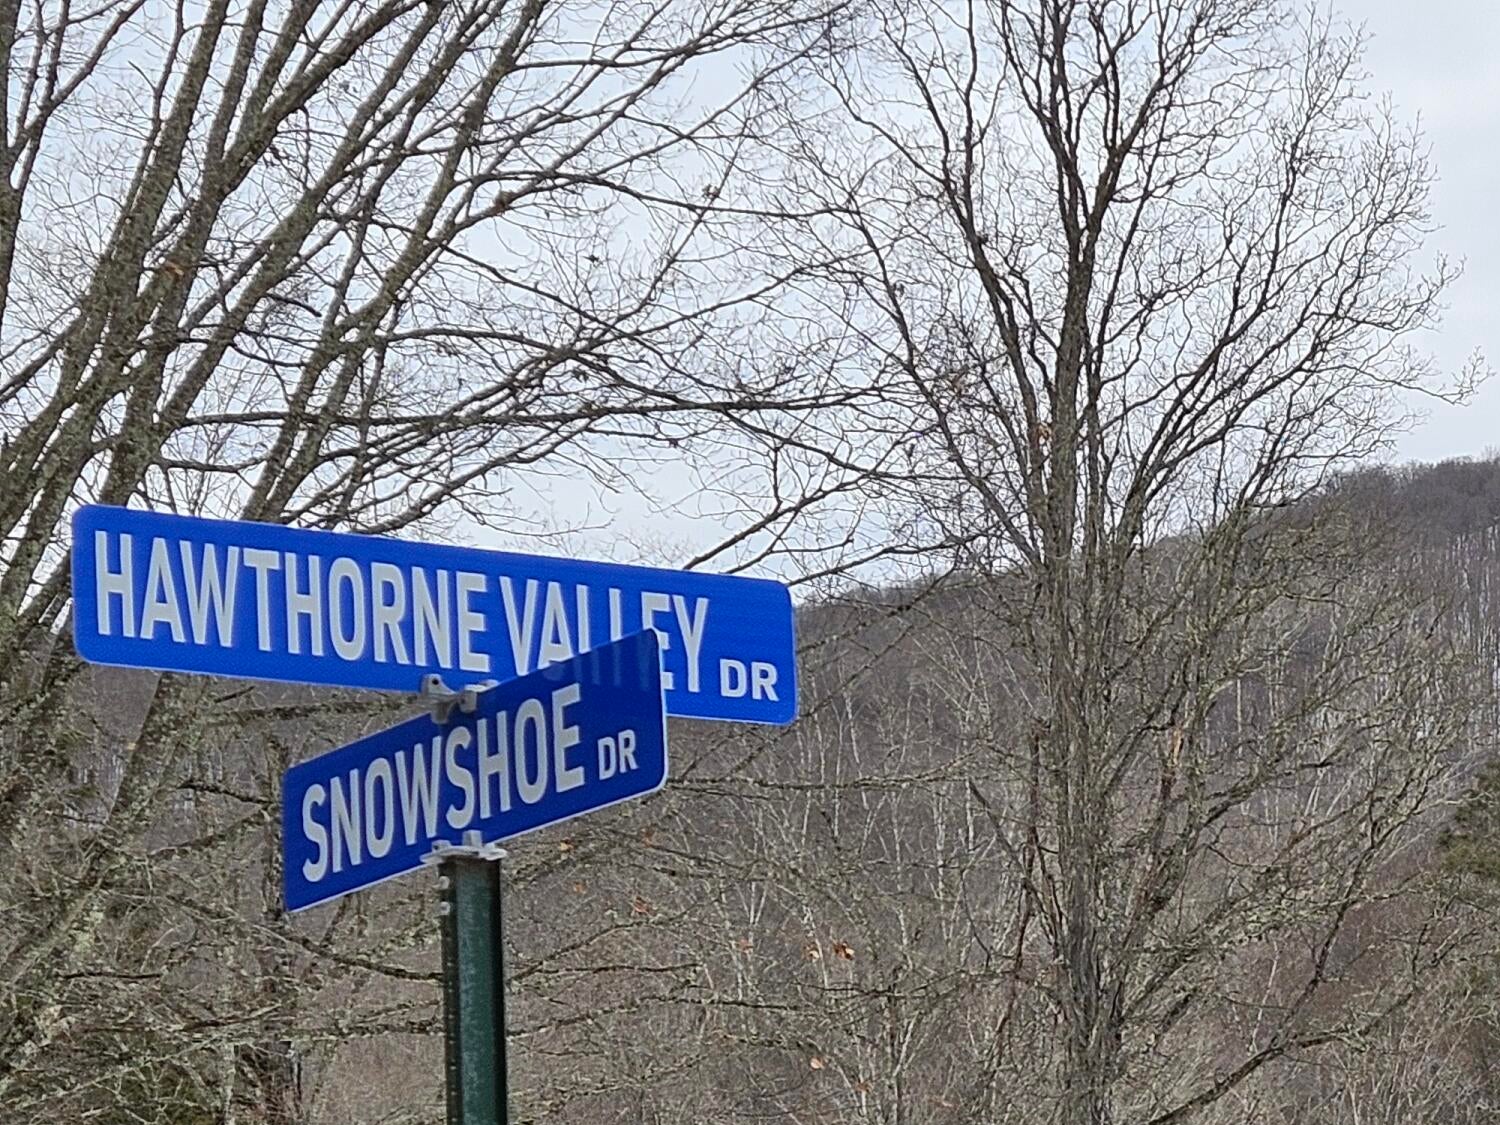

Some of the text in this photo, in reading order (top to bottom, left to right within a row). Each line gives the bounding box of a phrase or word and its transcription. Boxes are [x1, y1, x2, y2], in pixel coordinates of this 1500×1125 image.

[94, 529, 491, 673] HAWTHORNE
[719, 658, 780, 702] DR
[302, 683, 639, 884] SNOWSHOE DR
